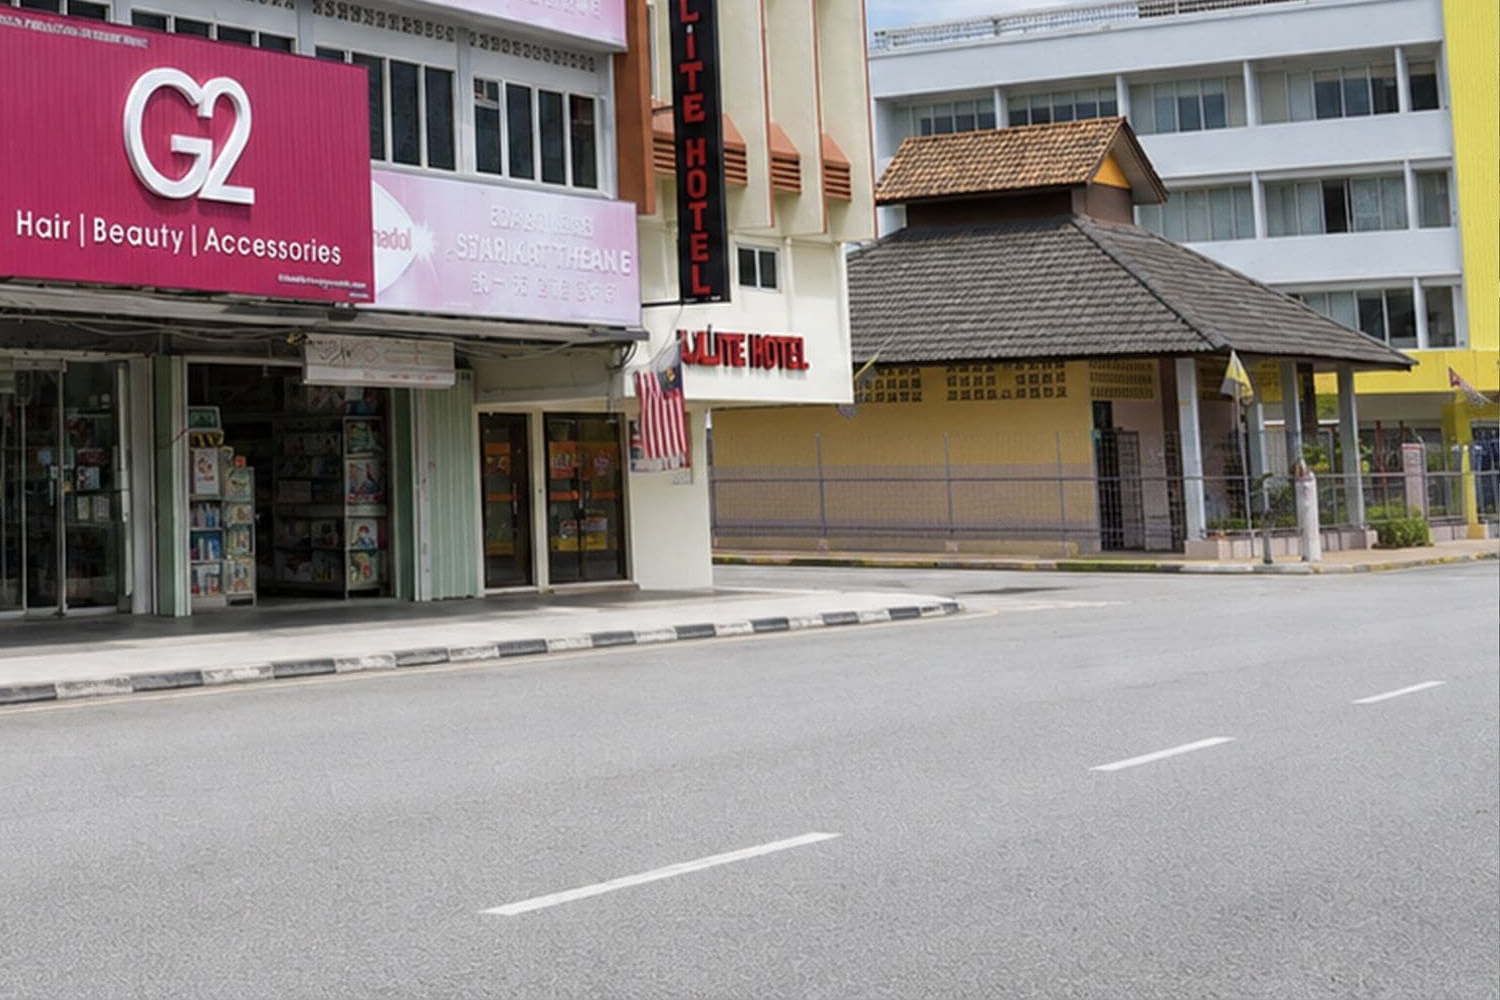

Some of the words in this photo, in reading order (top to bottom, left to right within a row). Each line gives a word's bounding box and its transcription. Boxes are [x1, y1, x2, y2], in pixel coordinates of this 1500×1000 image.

[123, 67, 256, 205] G2
[16, 210, 72, 240] Hair
[93, 217, 185, 256] Beauty
[203, 228, 343, 266] Accessories
[373, 228, 412, 251] nadol
[685, 137, 712, 295] HOTEL
